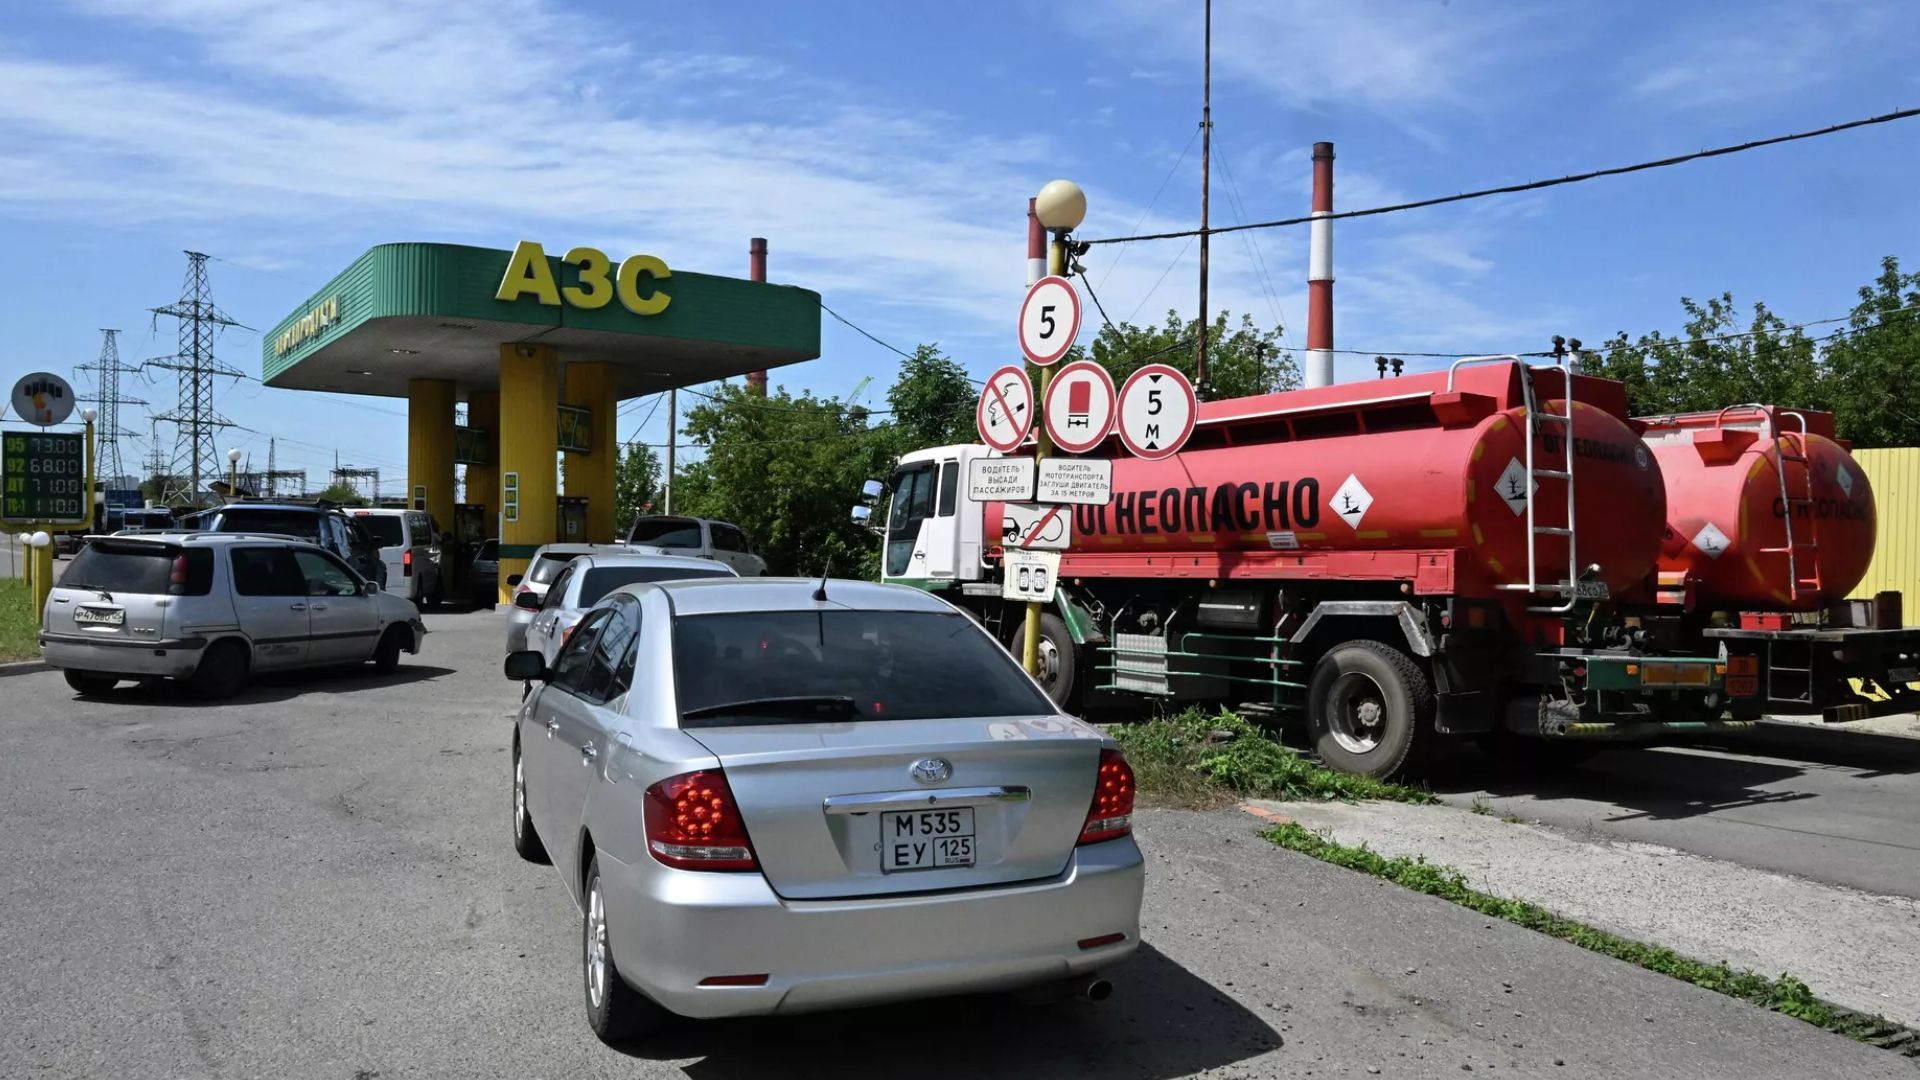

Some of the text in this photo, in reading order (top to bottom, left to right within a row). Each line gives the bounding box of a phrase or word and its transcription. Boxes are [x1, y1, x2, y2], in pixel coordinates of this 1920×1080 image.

[495, 240, 672, 316] АЗС
[1039, 305, 1056, 339] 5
[1147, 390, 1162, 416] 5
[1145, 424, 1159, 439] М
[6, 437, 79, 454] 95 73.00
[6, 458, 79, 474] 92 68.00
[1059, 464, 1091, 472] ВОДИТЕЛЬ
[988, 476, 1018, 484] ВЫСАДИ
[1045, 472, 1104, 481] МОТОТРАНСПОРТА
[7, 477, 78, 494] ДТ 71.00
[1040, 481, 1109, 490] ЗАГЛУШИ ДВИГАТЕЛЬ
[1069, 490, 1095, 498] МЕТРОВ
[1077, 477, 1319, 535] ОГНЕОПАСНО
[920, 812, 960, 835] 535
[895, 839, 970, 866] ЕУ 125
